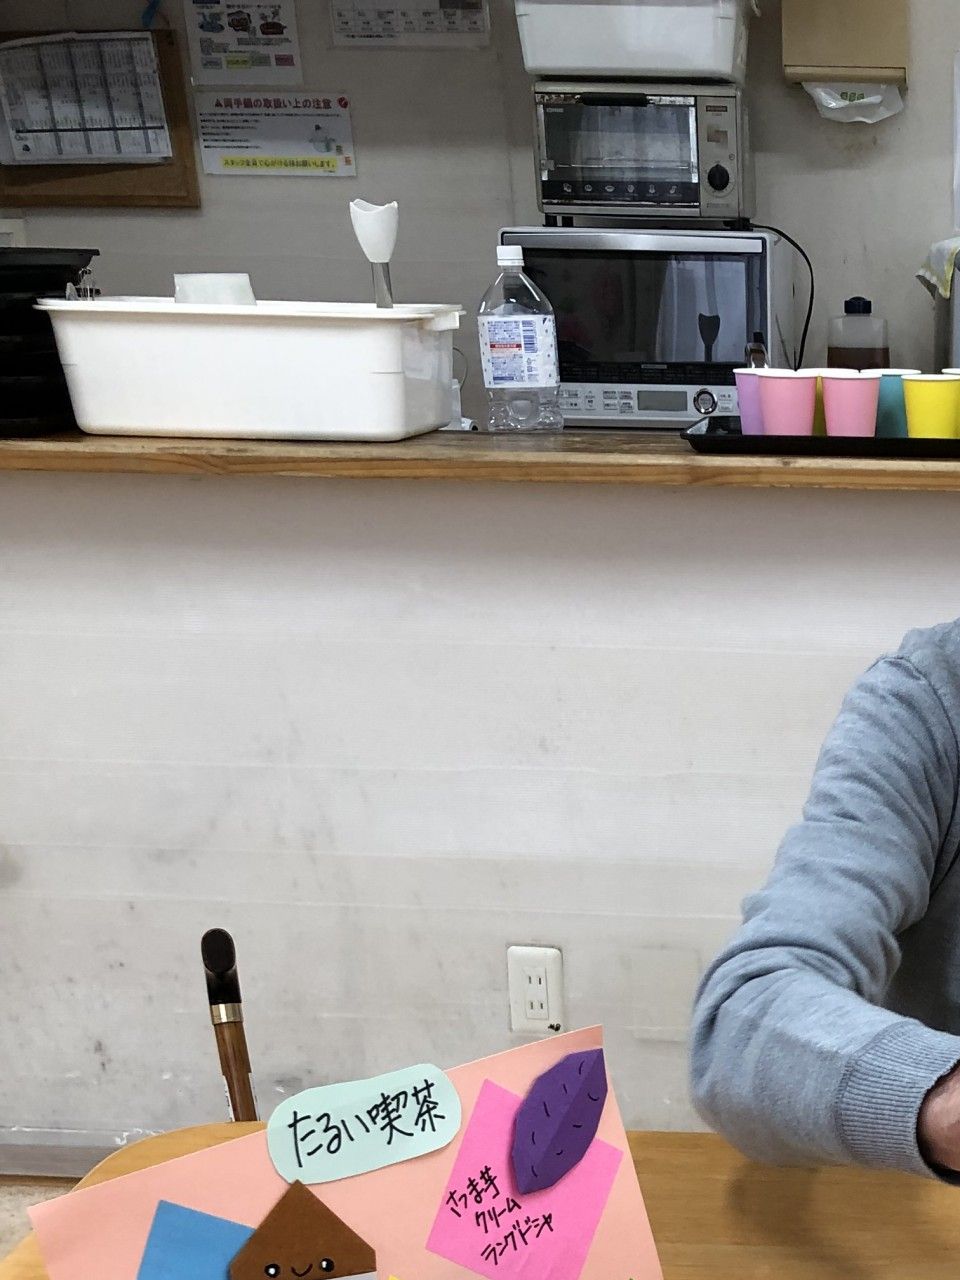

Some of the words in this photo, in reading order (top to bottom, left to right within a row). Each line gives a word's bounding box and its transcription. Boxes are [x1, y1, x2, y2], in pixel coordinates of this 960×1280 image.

[287, 1078, 446, 1168] たるい喫茶
[445, 1165, 500, 1217] さつま芋
[475, 1197, 522, 1234] クリーム
[480, 1212, 554, 1266] ラングドシャ
